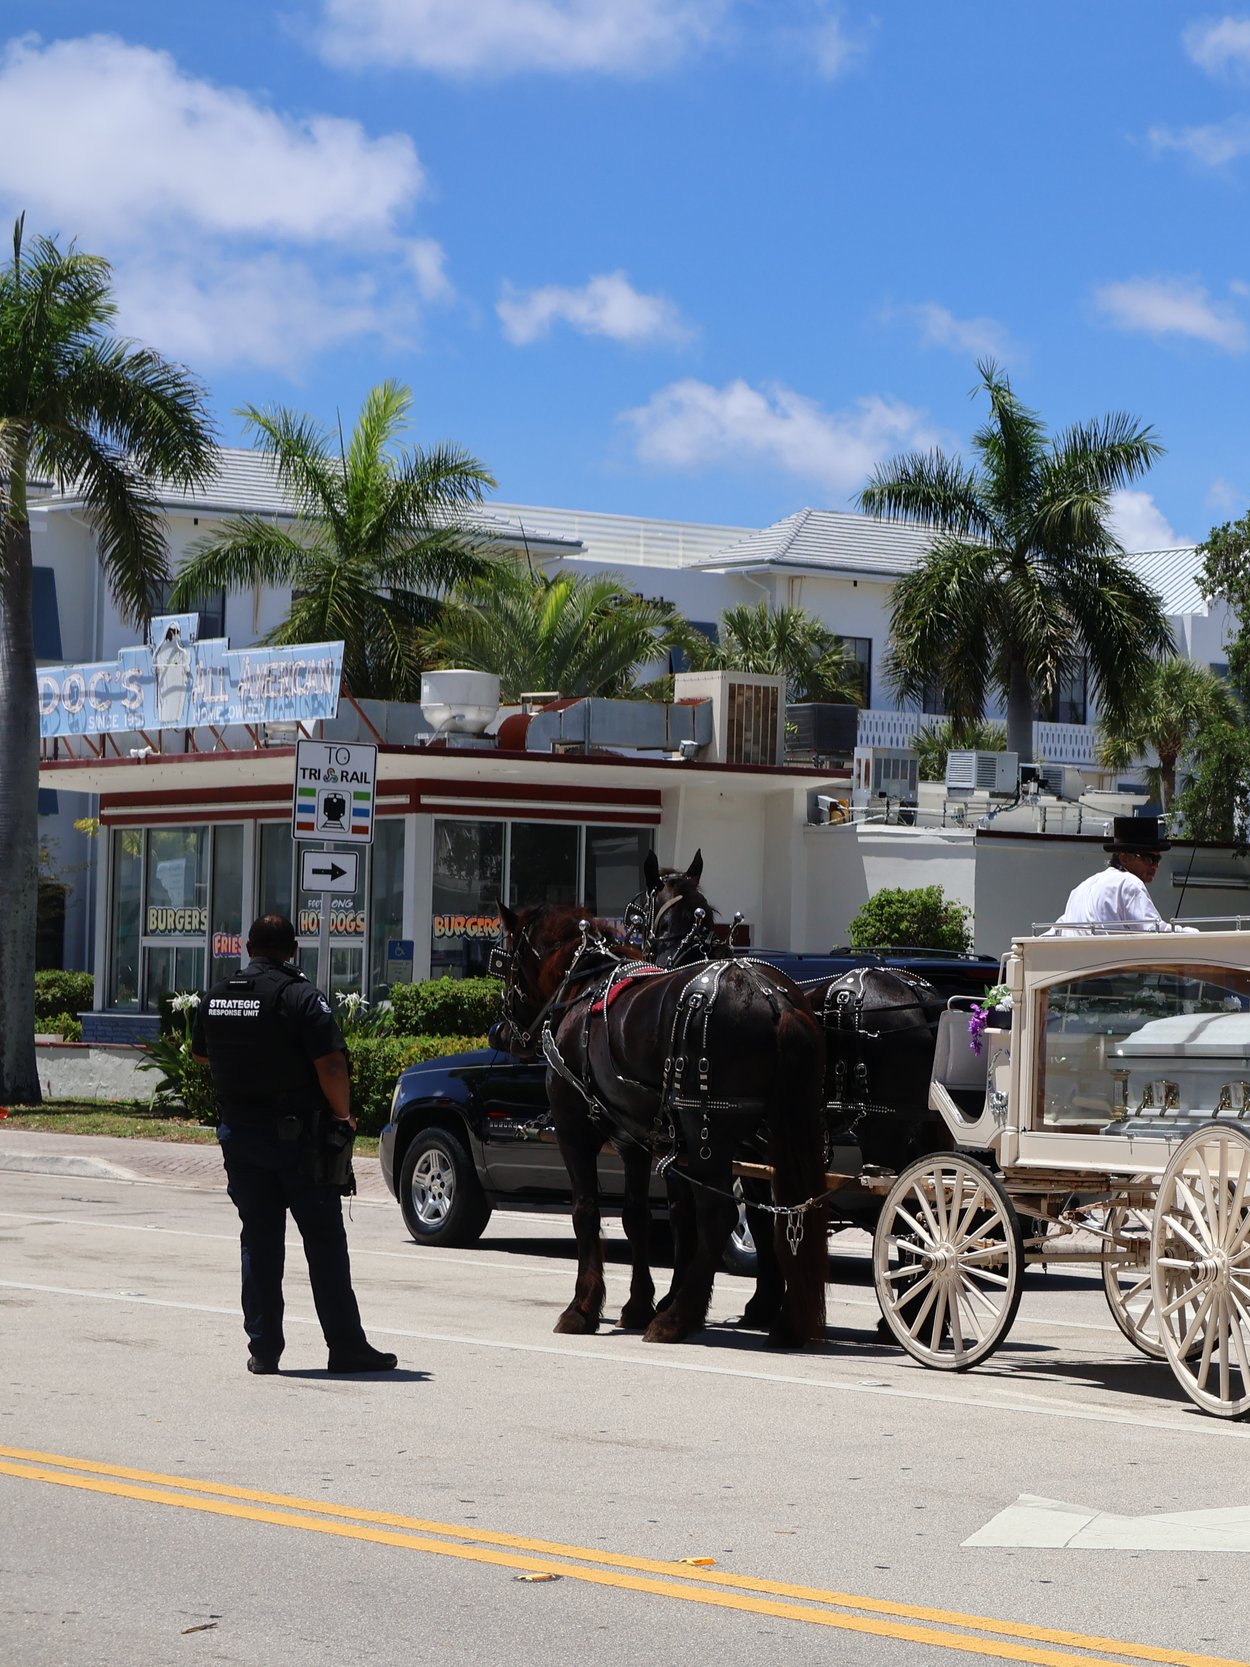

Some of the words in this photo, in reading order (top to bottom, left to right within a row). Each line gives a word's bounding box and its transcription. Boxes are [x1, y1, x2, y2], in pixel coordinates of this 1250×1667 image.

[192, 660, 228, 704] ALL
[238, 656, 334, 700] AMERICAN
[38, 667, 144, 715] DOC'S
[88, 714, 119, 730] SINCE
[193, 706, 221, 721] HOME
[324, 746, 350, 765] TO
[299, 767, 321, 781] TRI
[340, 770, 371, 784] RAIL
[331, 899, 354, 908] ONG
[148, 908, 207, 933] BURGERS
[330, 911, 365, 933] DOGS
[434, 915, 501, 938] BURGERS
[208, 1008, 242, 1016] RESPONSE
[209, 999, 260, 1009] STRATEGIC
